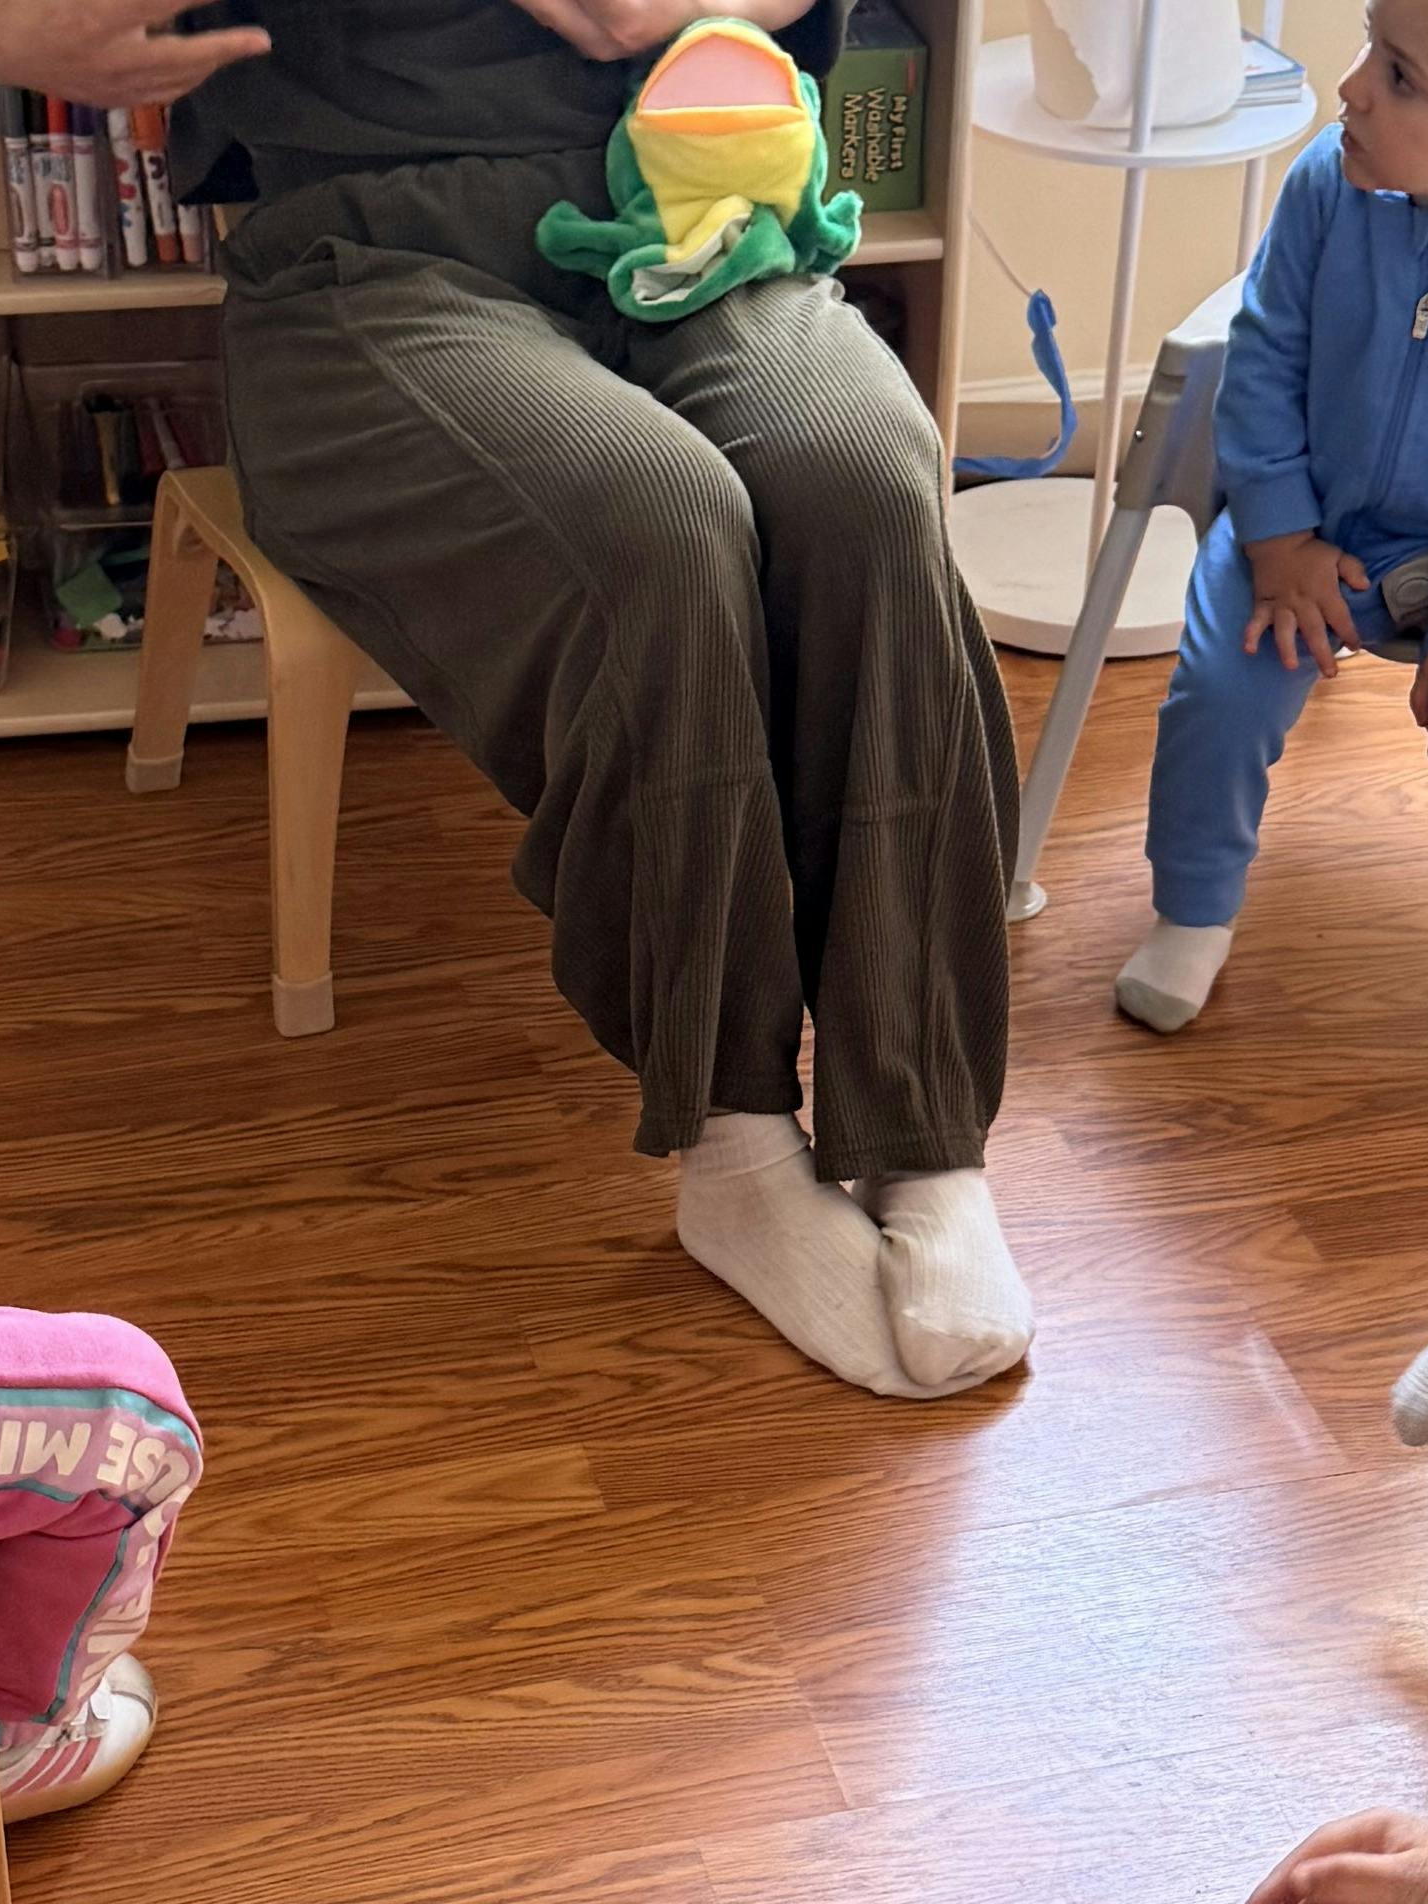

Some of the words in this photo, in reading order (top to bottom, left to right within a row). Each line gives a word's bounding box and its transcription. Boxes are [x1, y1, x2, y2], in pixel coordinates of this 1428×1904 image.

[841, 93, 864, 179] Markers
[864, 87, 888, 183] Washable
[889, 95, 908, 123] My
[890, 126, 908, 170] First
